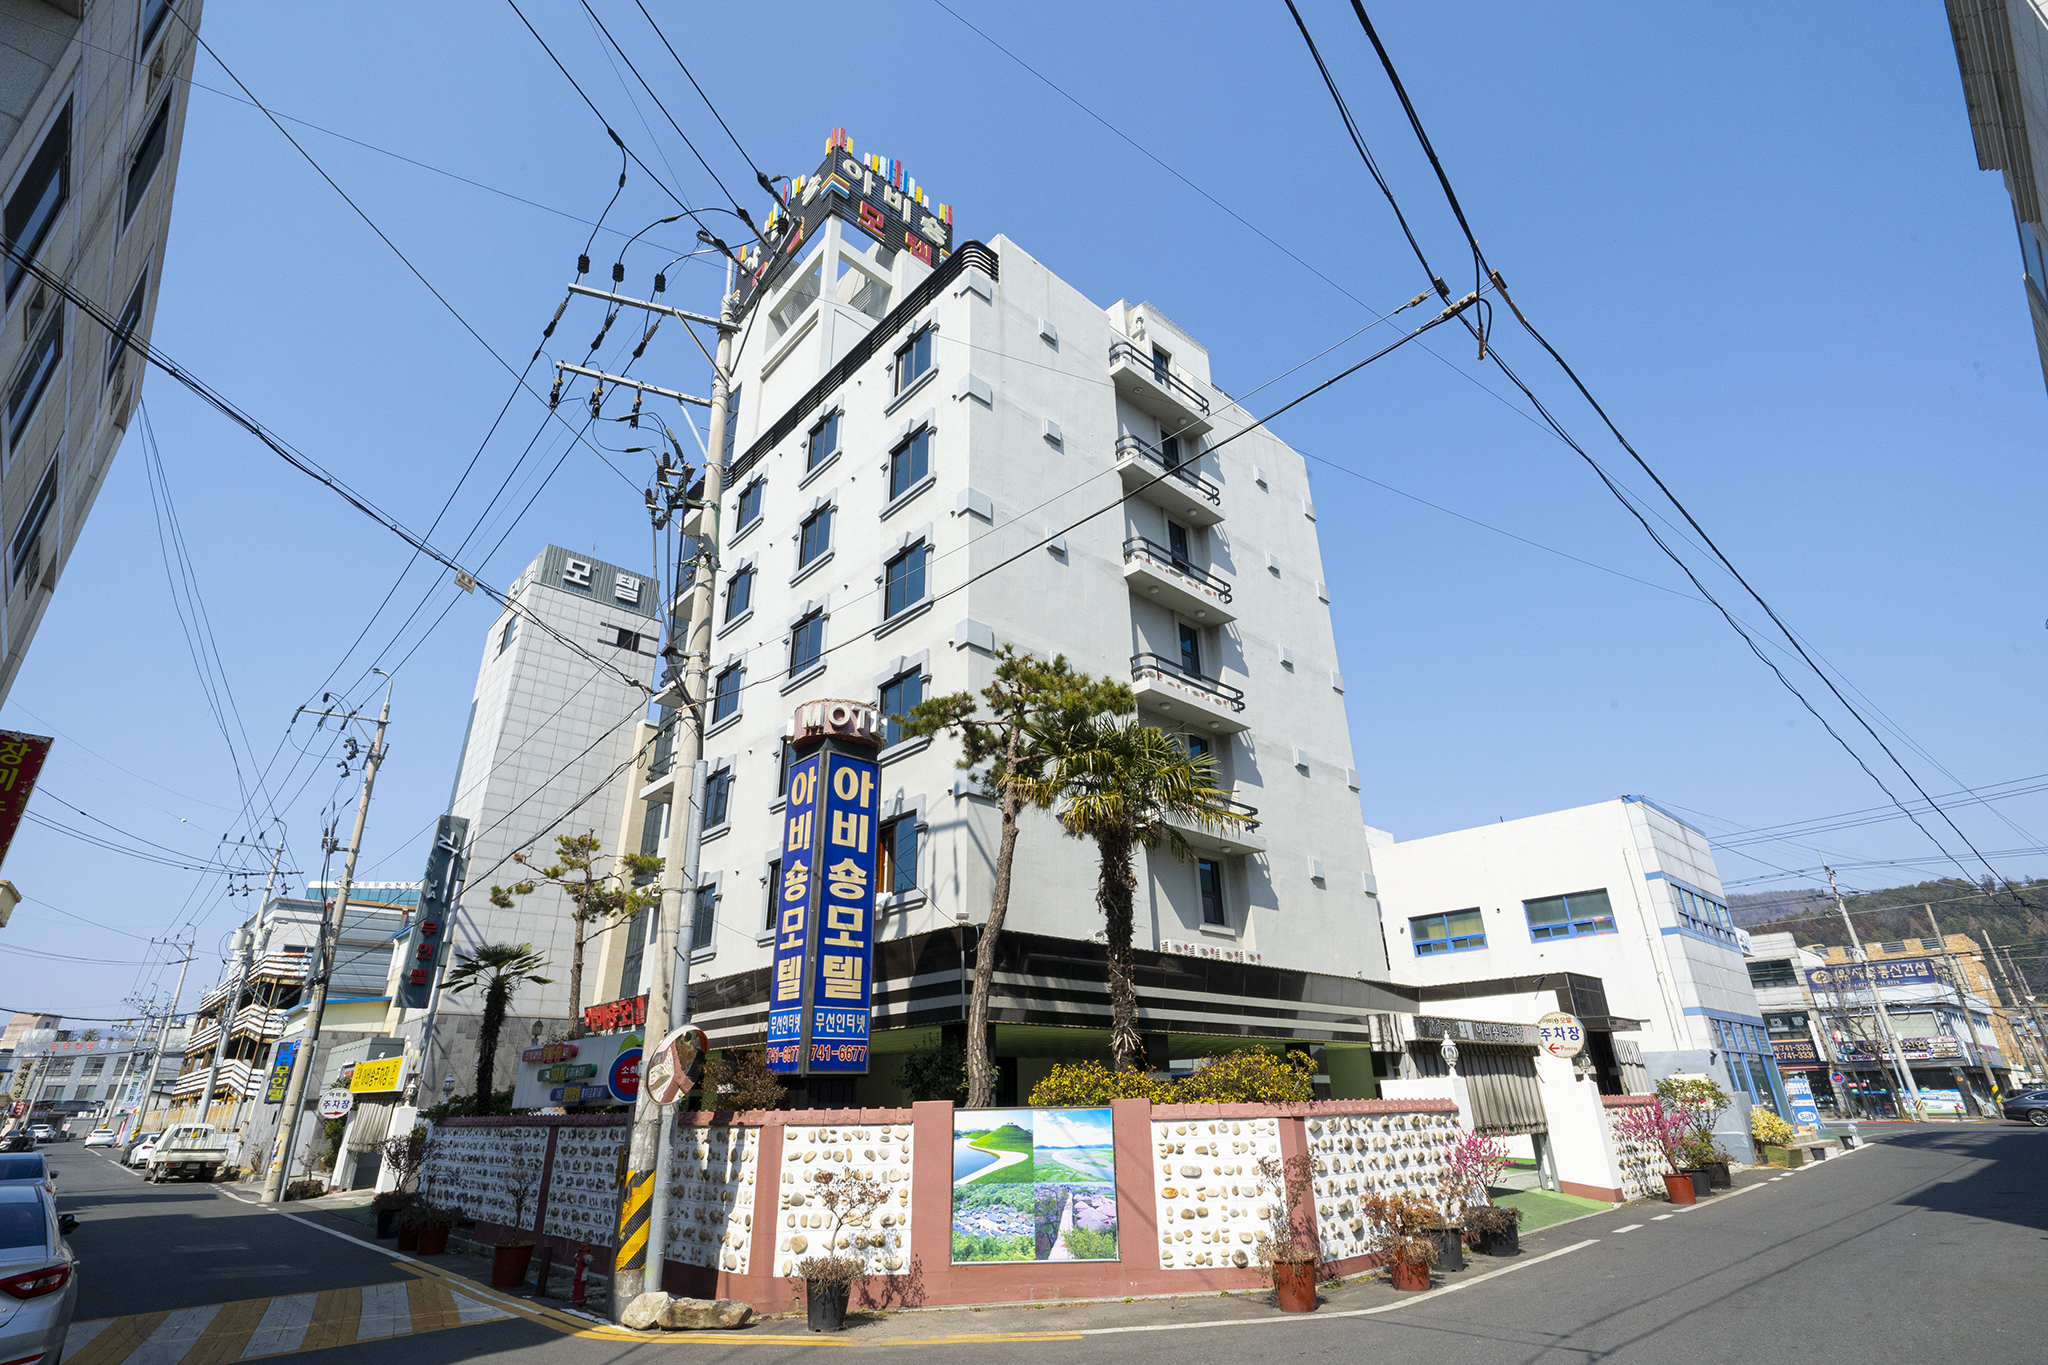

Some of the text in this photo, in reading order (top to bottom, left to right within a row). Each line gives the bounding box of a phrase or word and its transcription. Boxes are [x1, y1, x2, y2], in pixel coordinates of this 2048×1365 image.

[843, 159, 947, 247] 아비숑
[857, 200, 932, 266] 모텔
[563, 557, 640, 603] 모텔
[777, 766, 817, 1001] 아비숑모텔
[822, 766, 874, 1000] 아비숑모텔
[410, 921, 439, 985] 무인텔
[770, 1013, 801, 1035] 무선인터넷
[815, 1013, 866, 1034] 무선인터넷
[1475, 1023, 1500, 1043] 아비숑
[1500, 1025, 1524, 1044] 주차장
[1540, 1026, 1580, 1041] 주차장
[766, 1045, 800, 1064] 741-6677
[810, 1044, 867, 1062] 741-6677
[267, 1066, 291, 1101] 무인텔
[323, 1100, 350, 1109] 주차장
